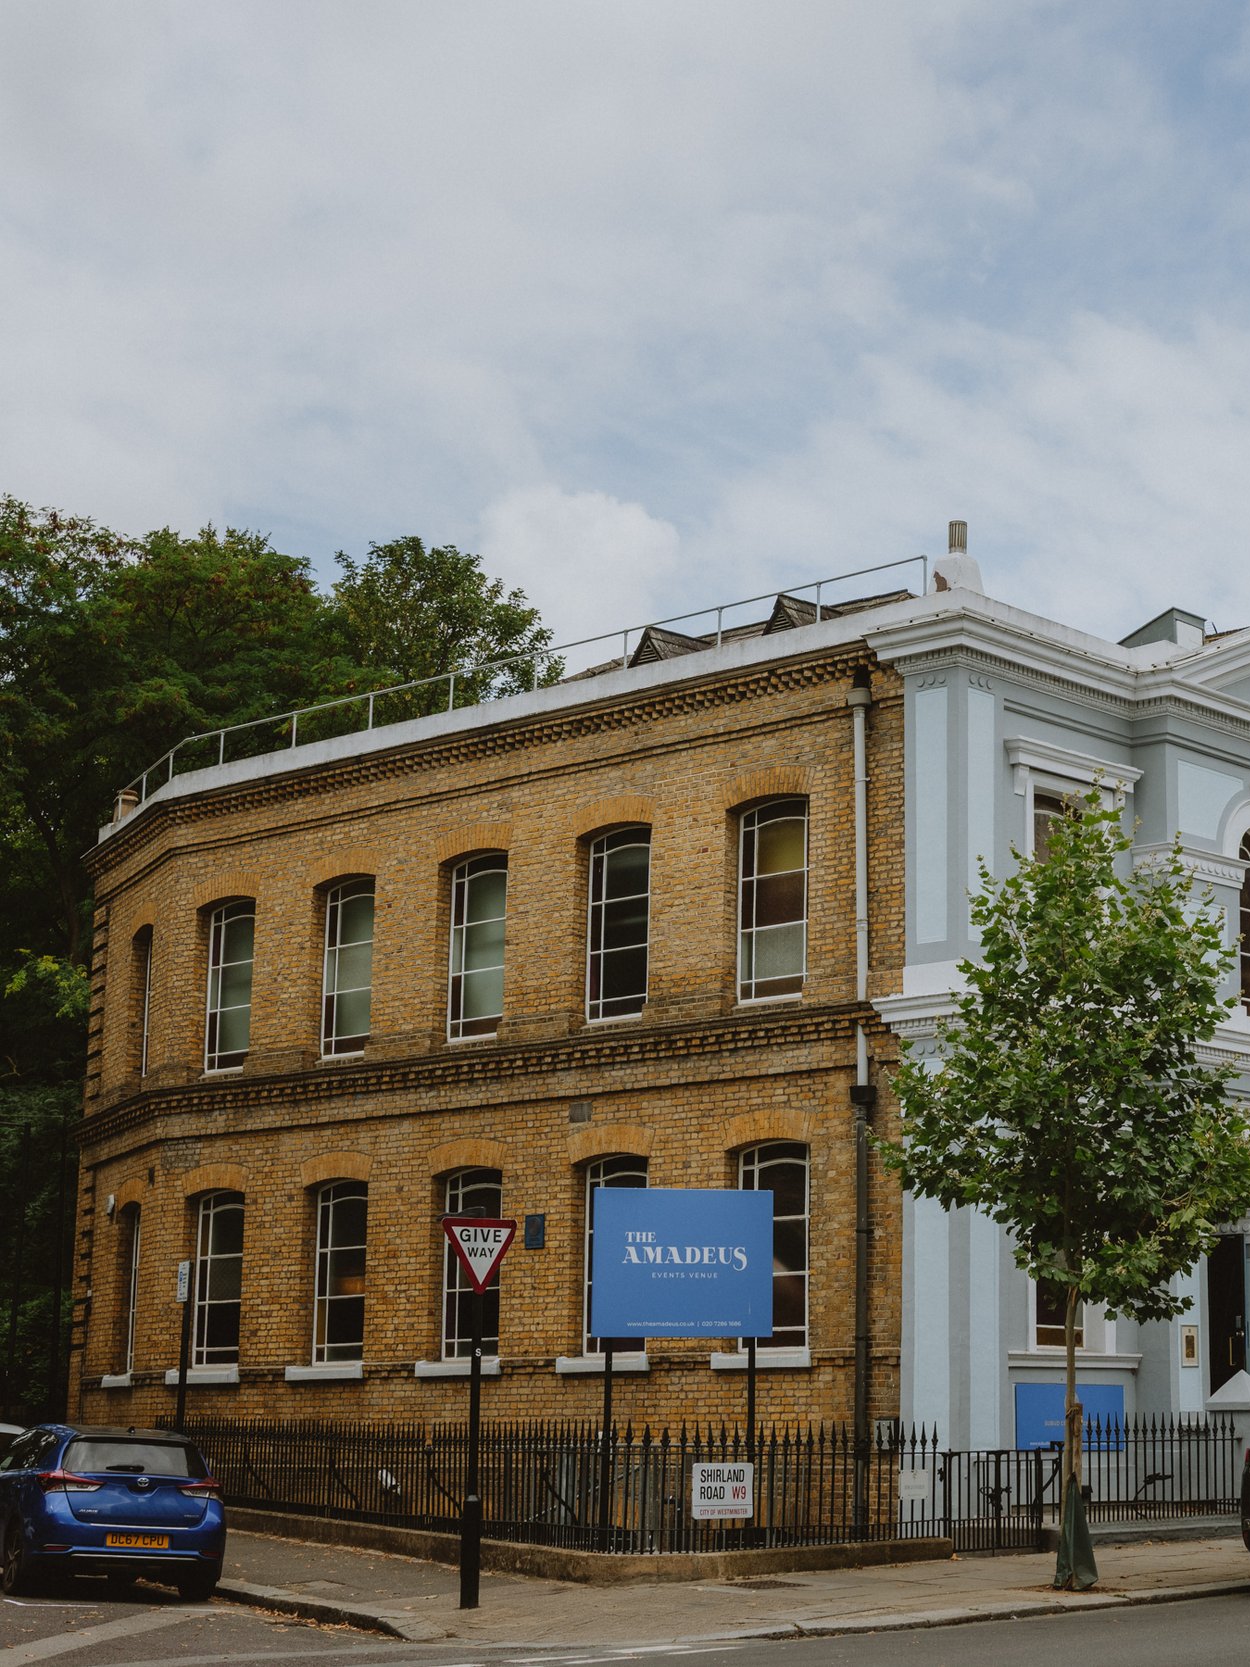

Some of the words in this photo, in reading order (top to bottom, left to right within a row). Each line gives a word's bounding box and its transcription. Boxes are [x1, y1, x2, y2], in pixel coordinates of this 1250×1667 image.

[459, 1228, 502, 1243] GIVE
[624, 1231, 657, 1243] THE
[467, 1246, 495, 1258] WAY
[622, 1246, 748, 1271] AMADEUS
[700, 1469, 745, 1483] SHIRLAND
[699, 1486, 725, 1500] ROAD
[732, 1485, 747, 1500] W9
[110, 1533, 140, 1545] DC67
[142, 1535, 165, 1546] CPU
